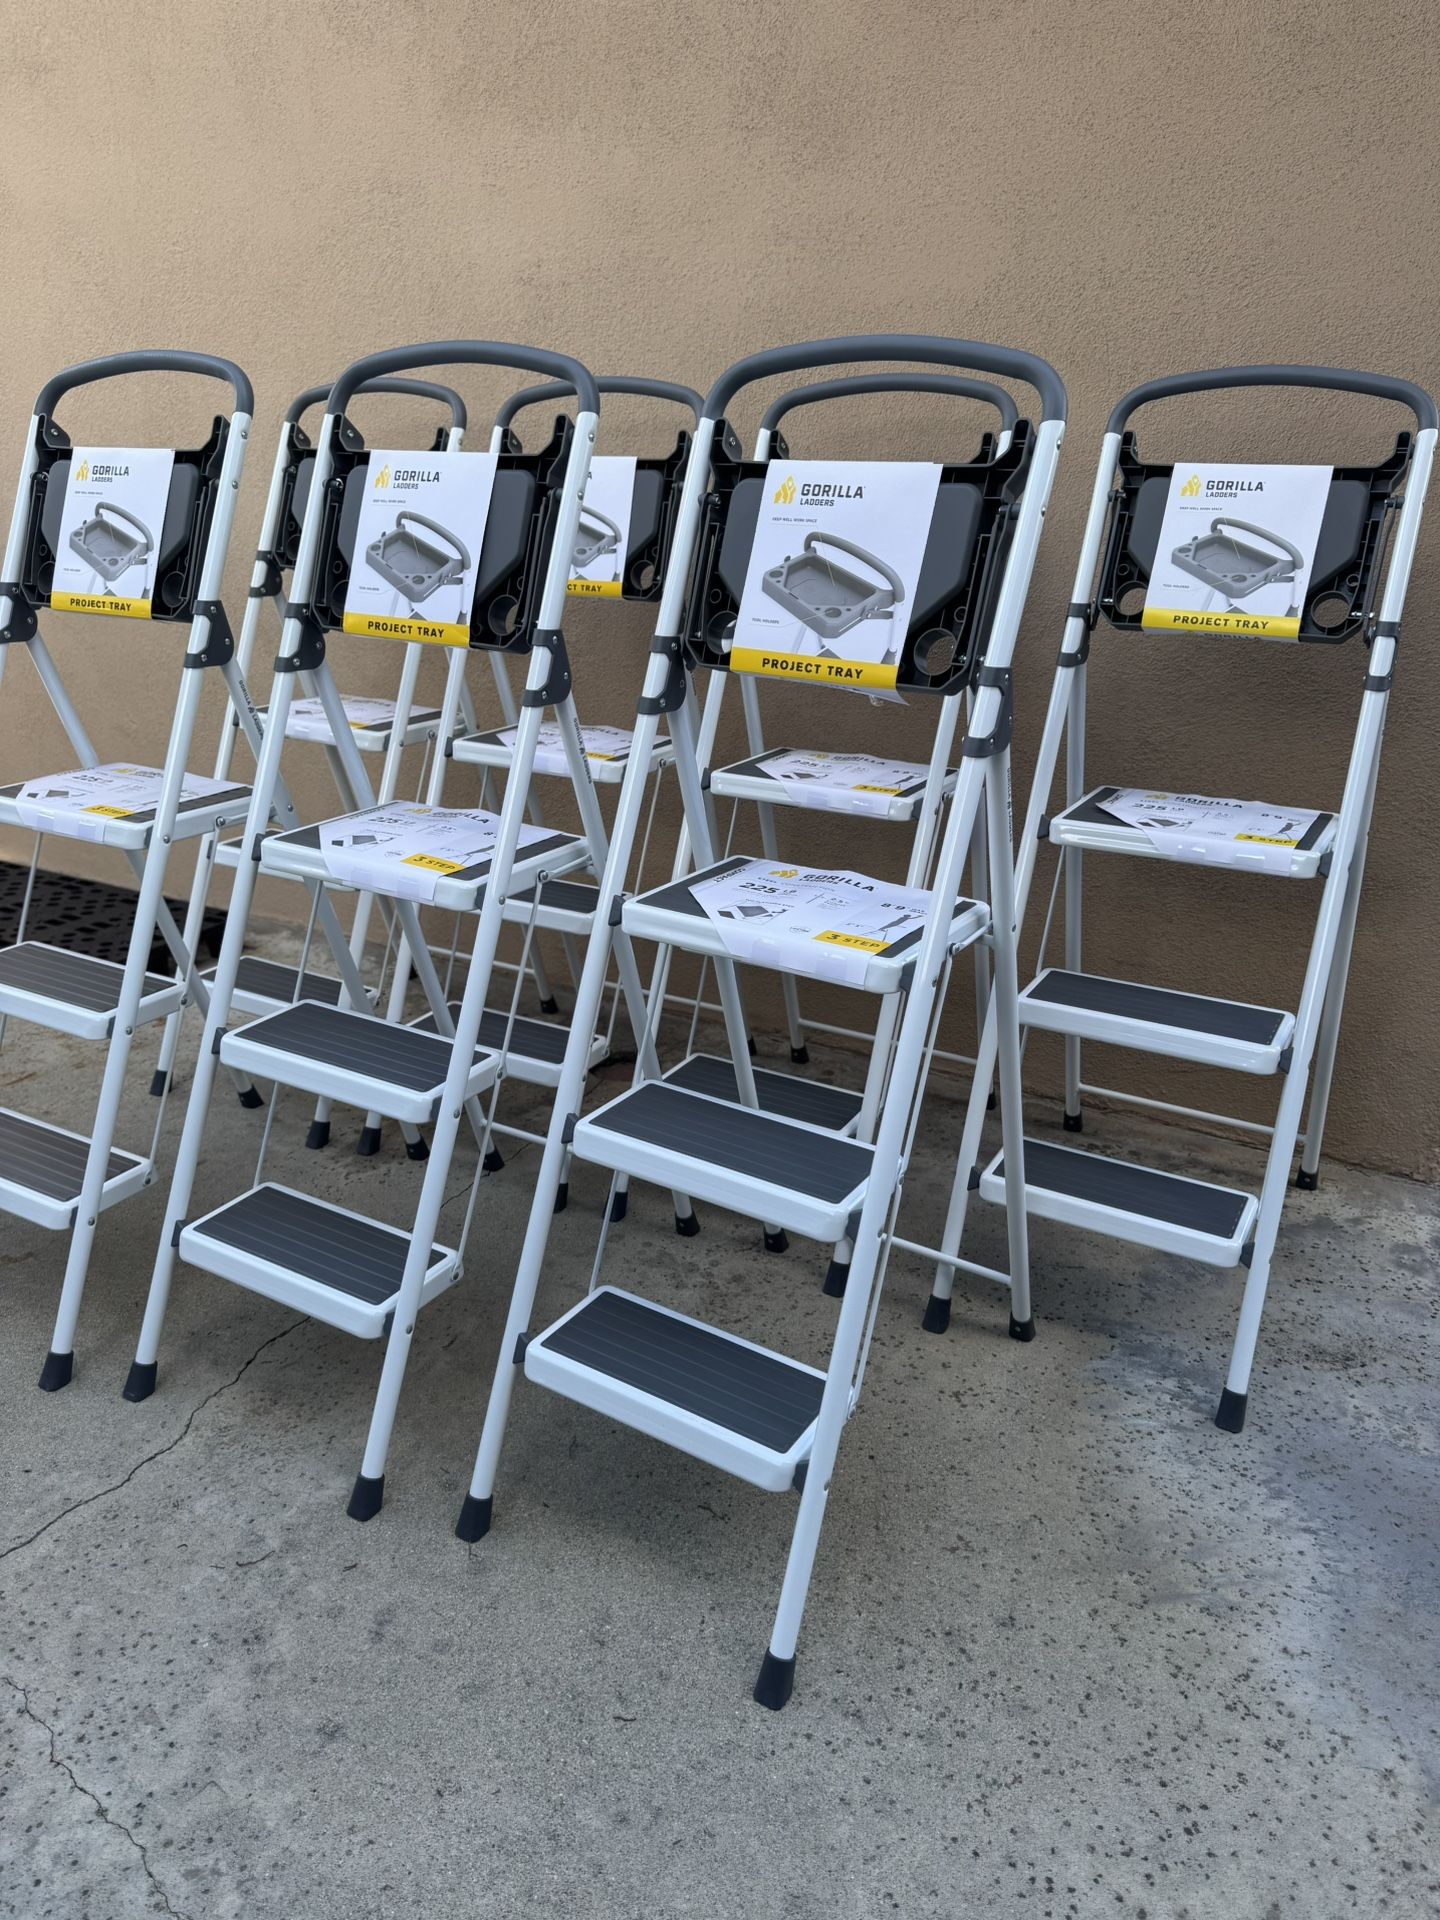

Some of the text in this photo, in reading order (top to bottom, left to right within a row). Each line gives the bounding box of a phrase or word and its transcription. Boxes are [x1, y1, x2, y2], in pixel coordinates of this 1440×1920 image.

[92, 465, 130, 477] GORILLA
[394, 470, 440, 483] GORILLA
[393, 482, 419, 490] LADDERS
[800, 483, 864, 499] GORILLA
[1206, 480, 1264, 492] GORILLA
[800, 498, 835, 507] LADDERS
[581, 584, 602, 592] TRAY
[70, 598, 132, 612] PROJECT TRAY
[1173, 615, 1269, 630] PROJECT TRAY
[367, 620, 445, 638] PROJECT TRAY
[762, 657, 864, 680] PROJECT TRAY
[738, 882, 780, 894] 225
[801, 873, 875, 893] GORILLA
[842, 938, 881, 948] STEP
